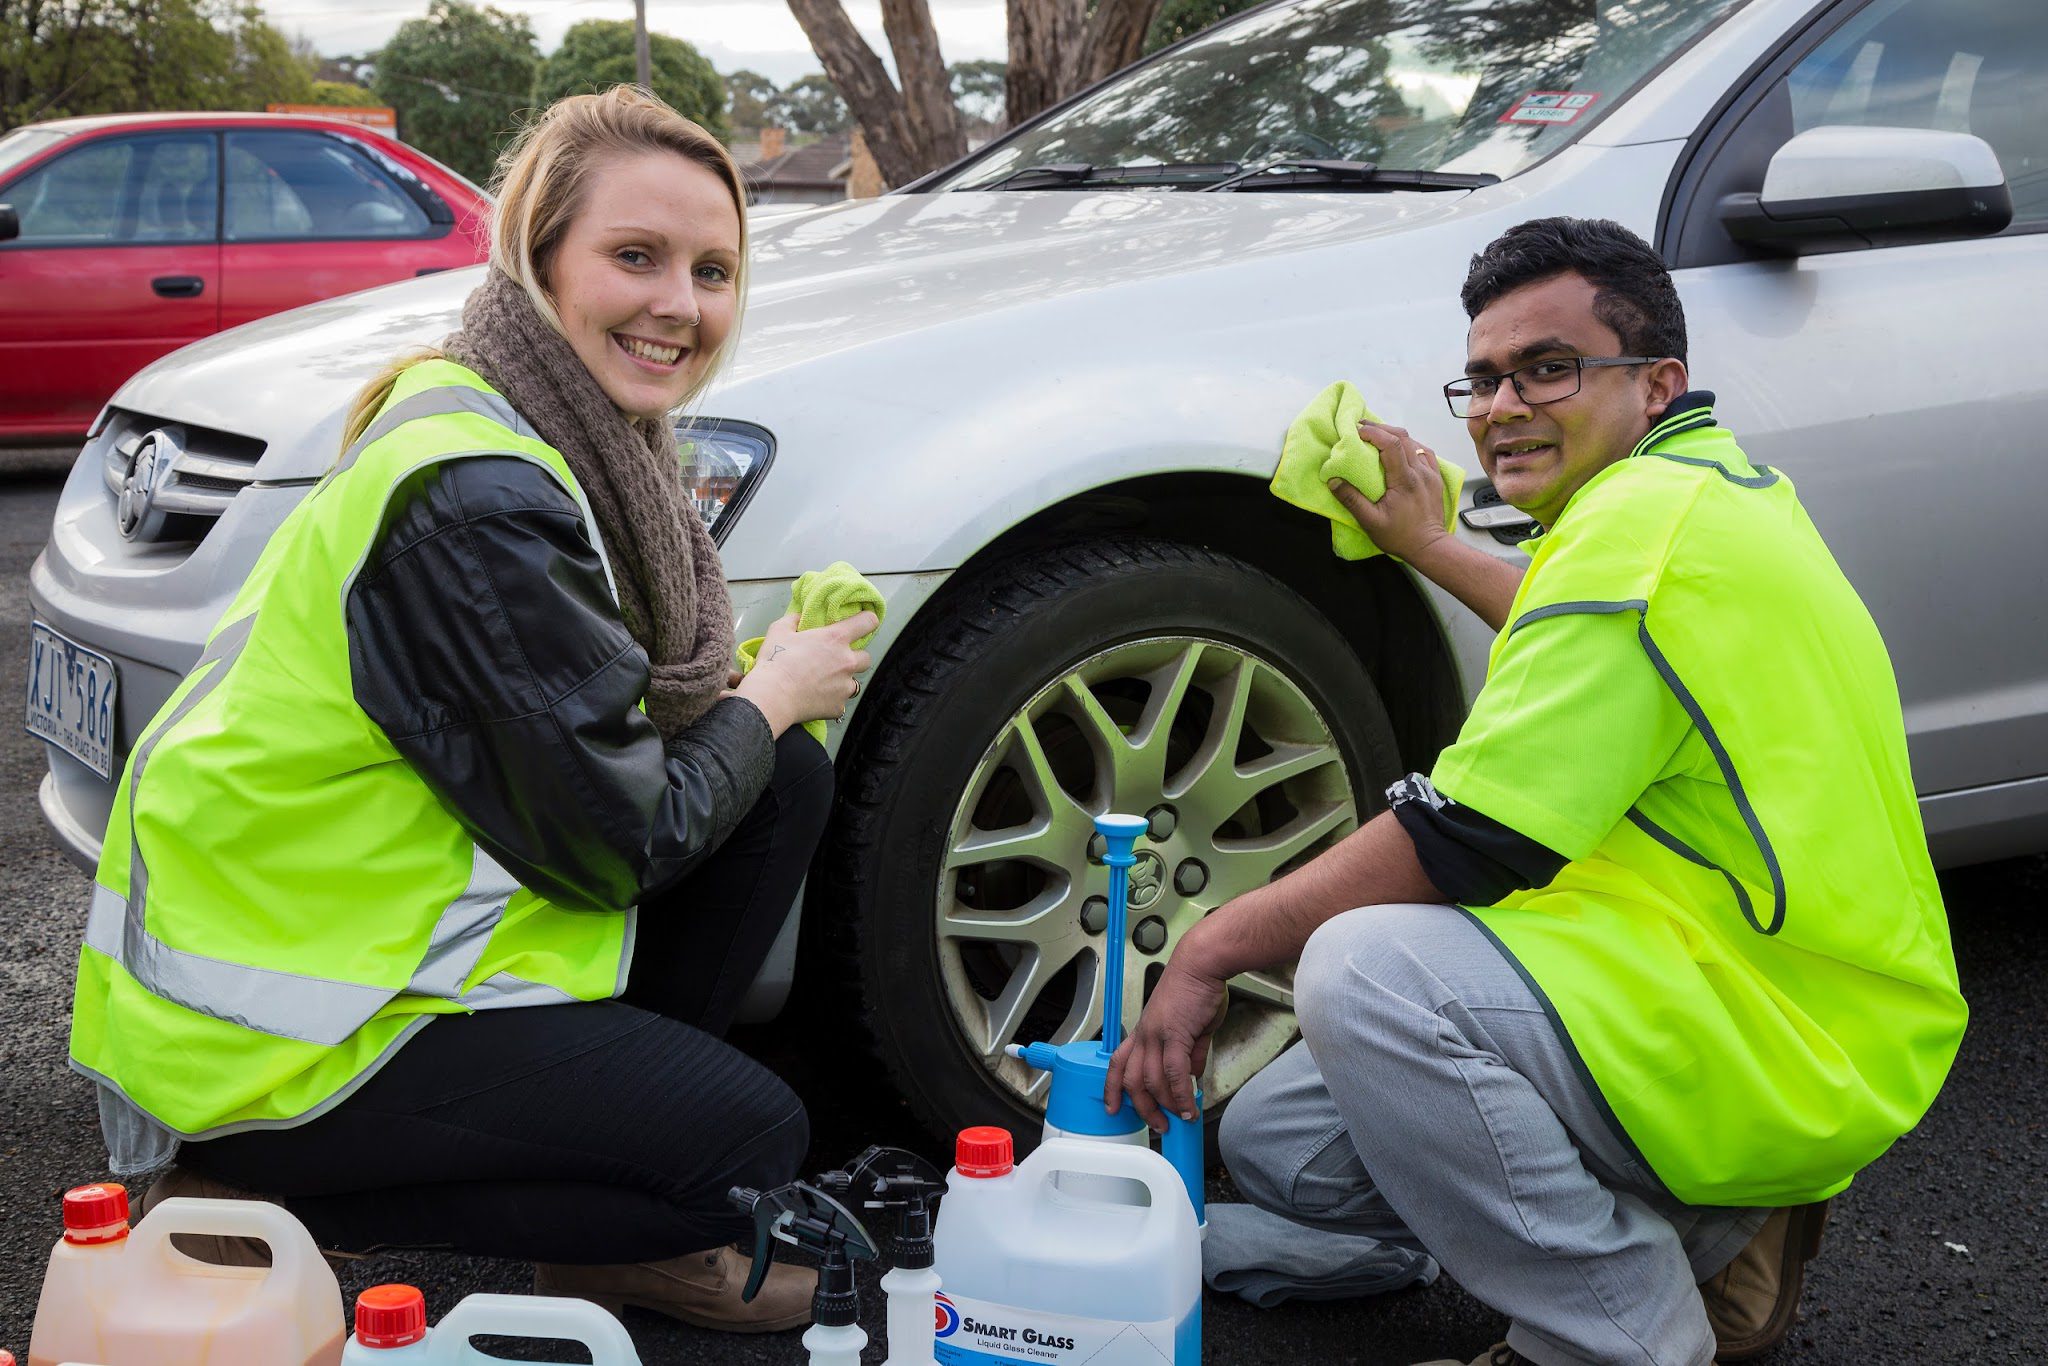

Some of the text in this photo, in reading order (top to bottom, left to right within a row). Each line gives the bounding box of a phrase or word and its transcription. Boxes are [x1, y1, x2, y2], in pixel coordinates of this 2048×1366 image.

[76, 662, 112, 747] 586
[31, 710, 57, 737] VICTORIA
[63, 728, 73, 748] THE
[75, 735, 90, 759] PLACE
[91, 746, 99, 765] TO
[101, 752, 108, 771] BE
[962, 1317, 1075, 1351] SMART GLASS
[977, 1338, 1059, 1360] Liquid Glass Cleaner
